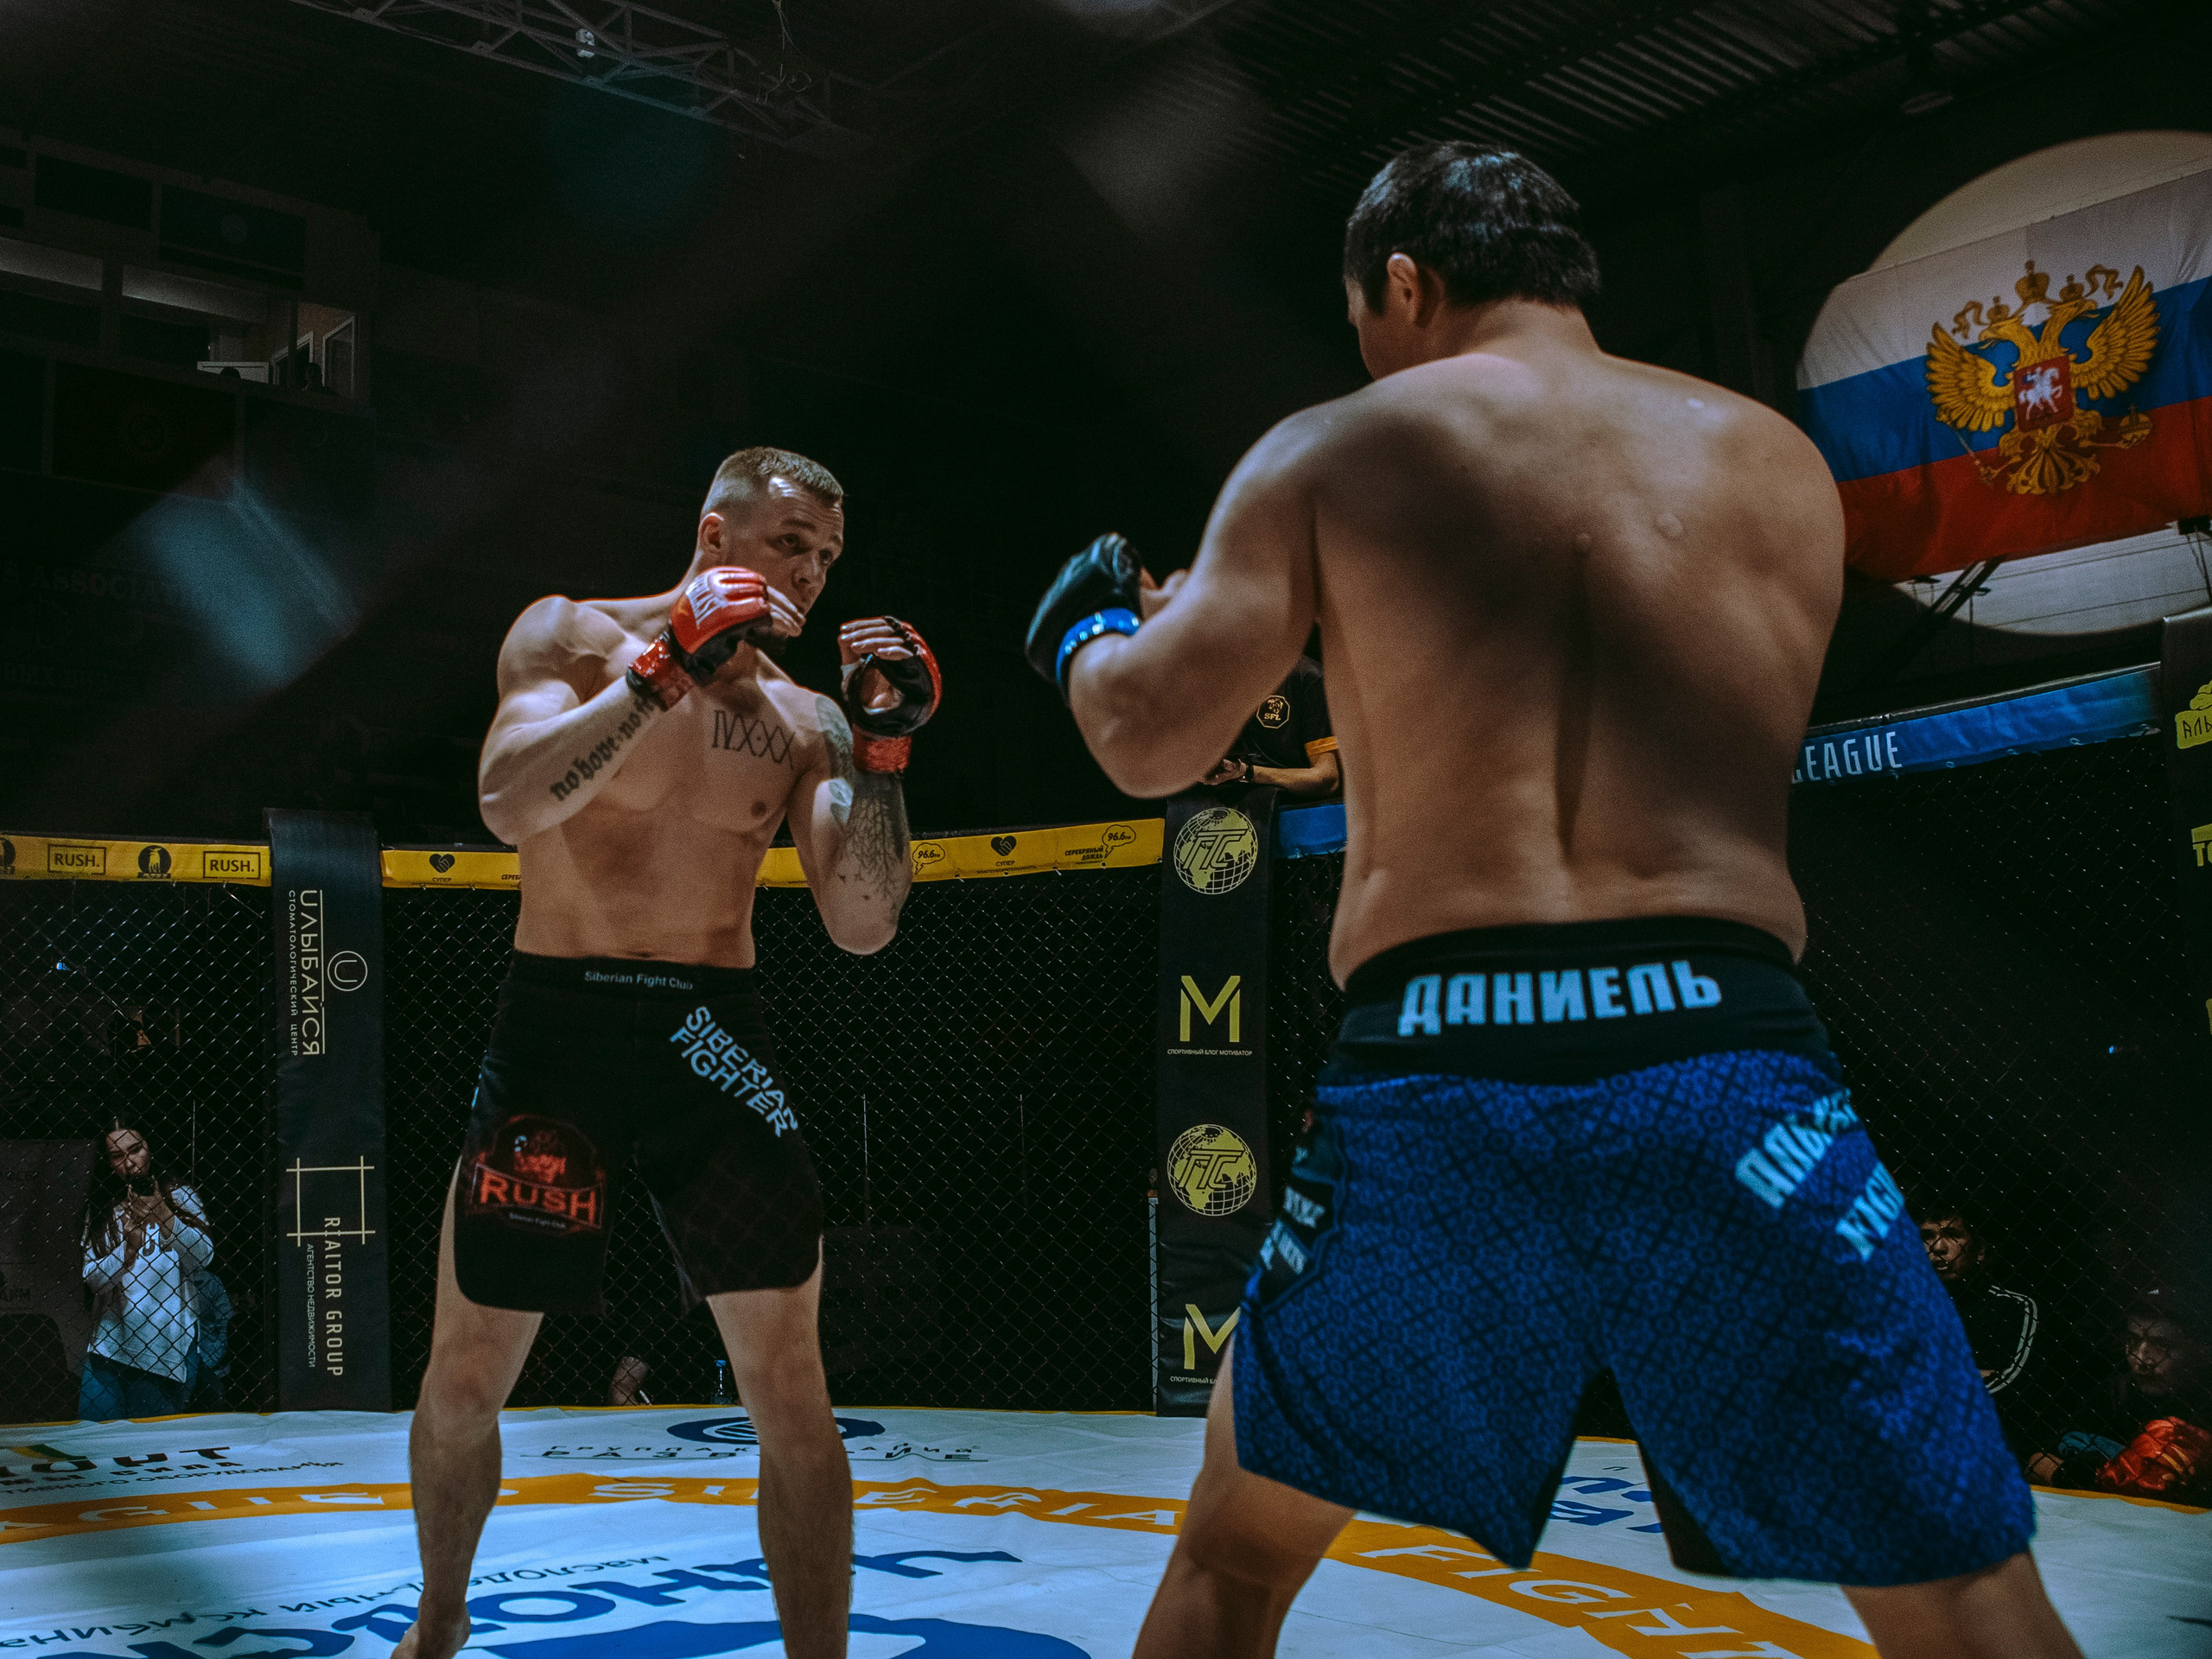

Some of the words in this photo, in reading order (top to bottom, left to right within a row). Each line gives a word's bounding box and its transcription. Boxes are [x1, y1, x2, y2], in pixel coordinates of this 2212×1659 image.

[1791, 731, 1903, 786] EAGUE
[289, 890, 298, 1016] СТОМАТОЛОГИЧЕСКИЙ
[584, 970, 633, 983] Siberian
[636, 973, 667, 988] Fight
[1397, 960, 1722, 1037] ДАНИЕЛЬ
[669, 1026, 788, 1138] FIGHTER
[686, 1006, 798, 1130] SIBERIAN
[480, 1169, 596, 1226] RUSH
[307, 1295, 316, 1368] НЕДВИЖИМОСТИ
[326, 1310, 343, 1376] GROUP
